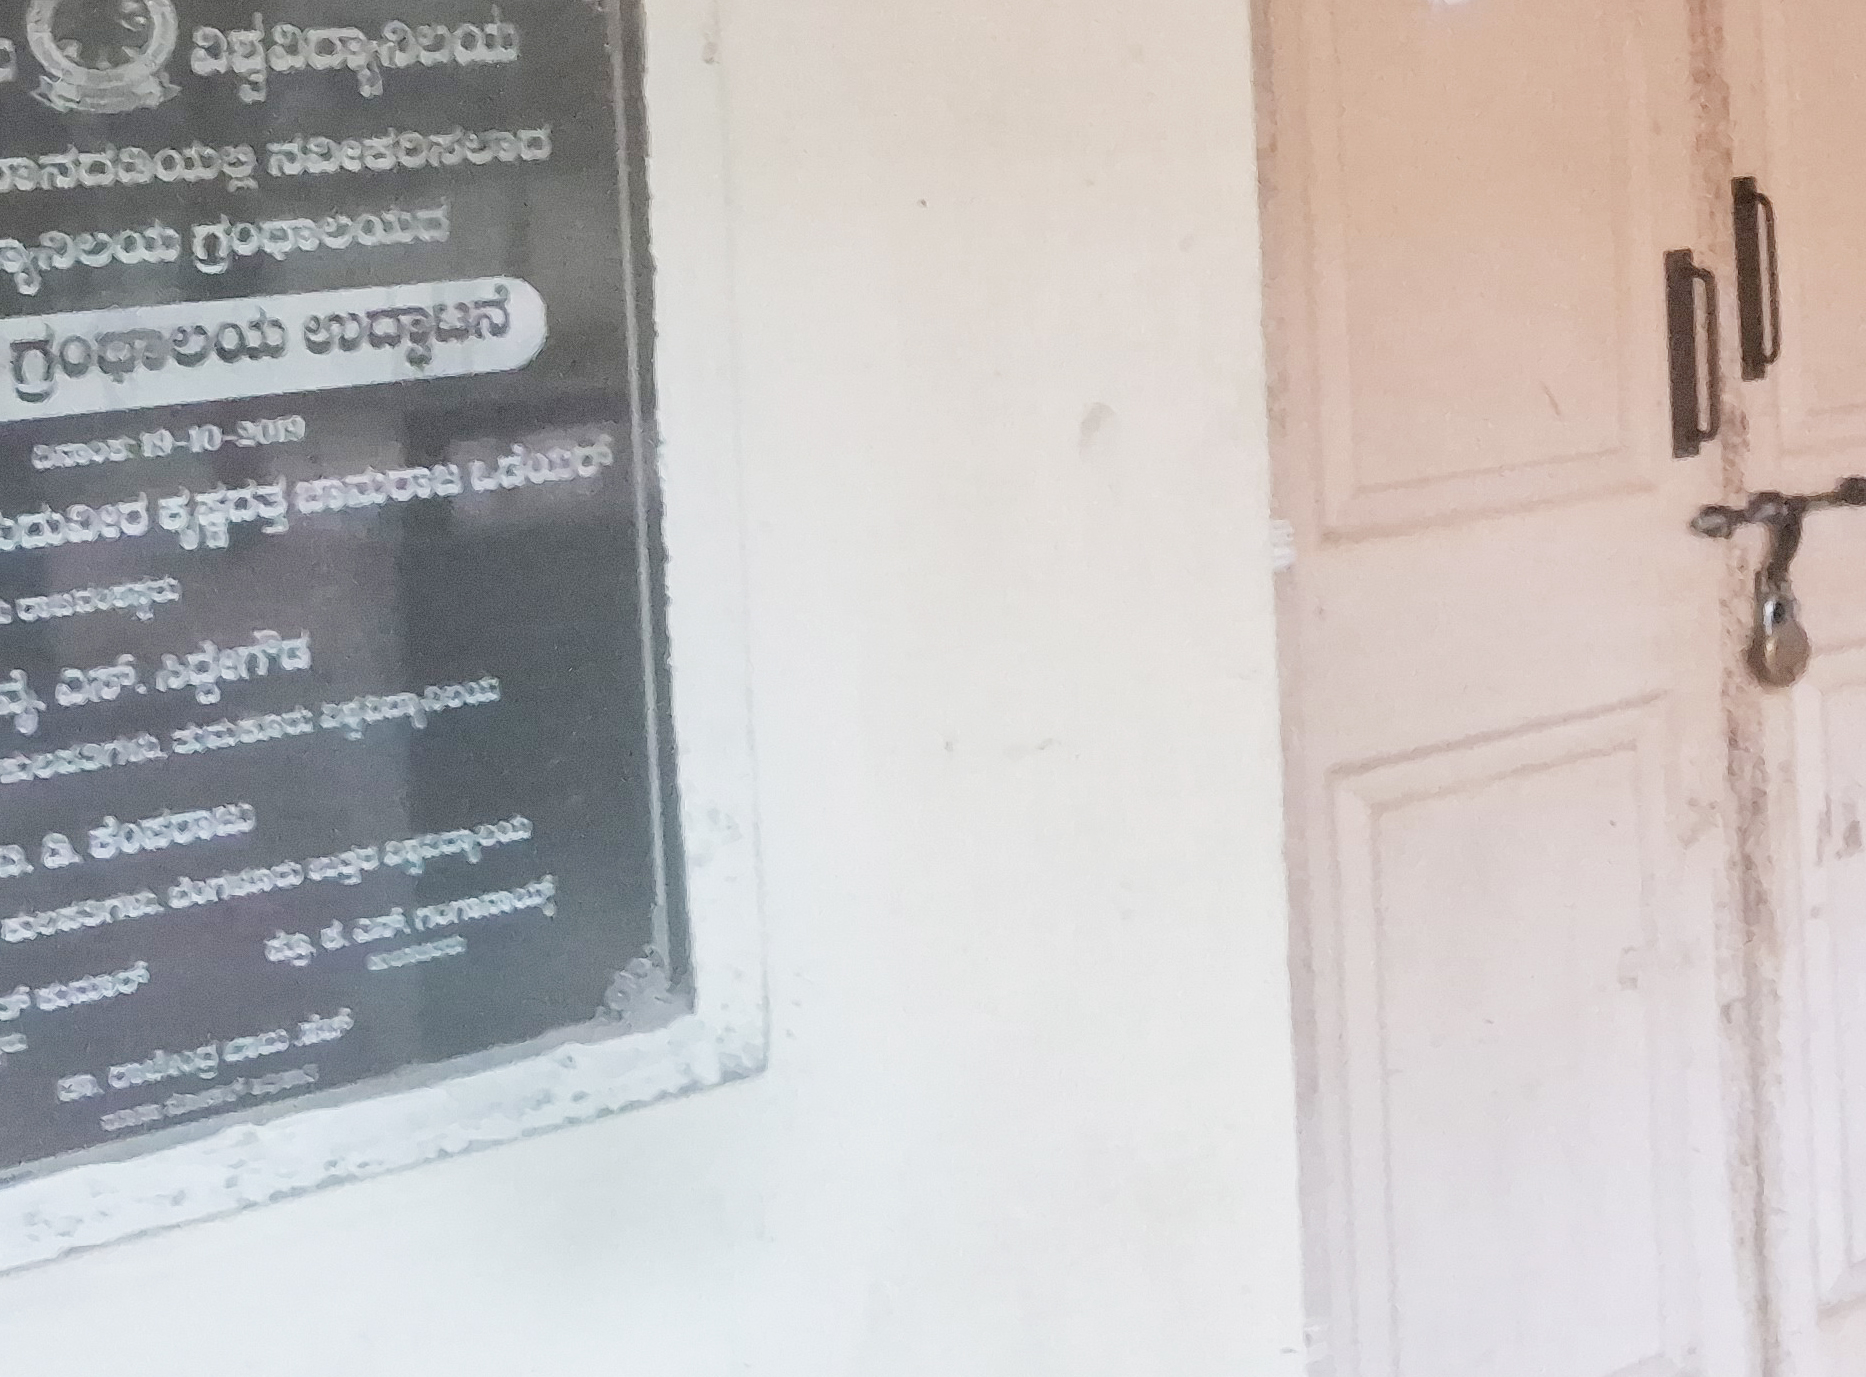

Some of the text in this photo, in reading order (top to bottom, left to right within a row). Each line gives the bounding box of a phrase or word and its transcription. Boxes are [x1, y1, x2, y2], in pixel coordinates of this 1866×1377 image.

[191, 9, 518, 103] ವಿಶ್ವವಿದ್ಯಾನಿಲಯ
[268, 124, 552, 177] ನವೀಕರಿಸಲಾದ
[191, 198, 451, 274] ಗ್ರಂಥಾಲಯದ
[10, 283, 512, 403] ಗ್ರಂಥಾಲಯ ಉದ್ಘಾಟನೆ
